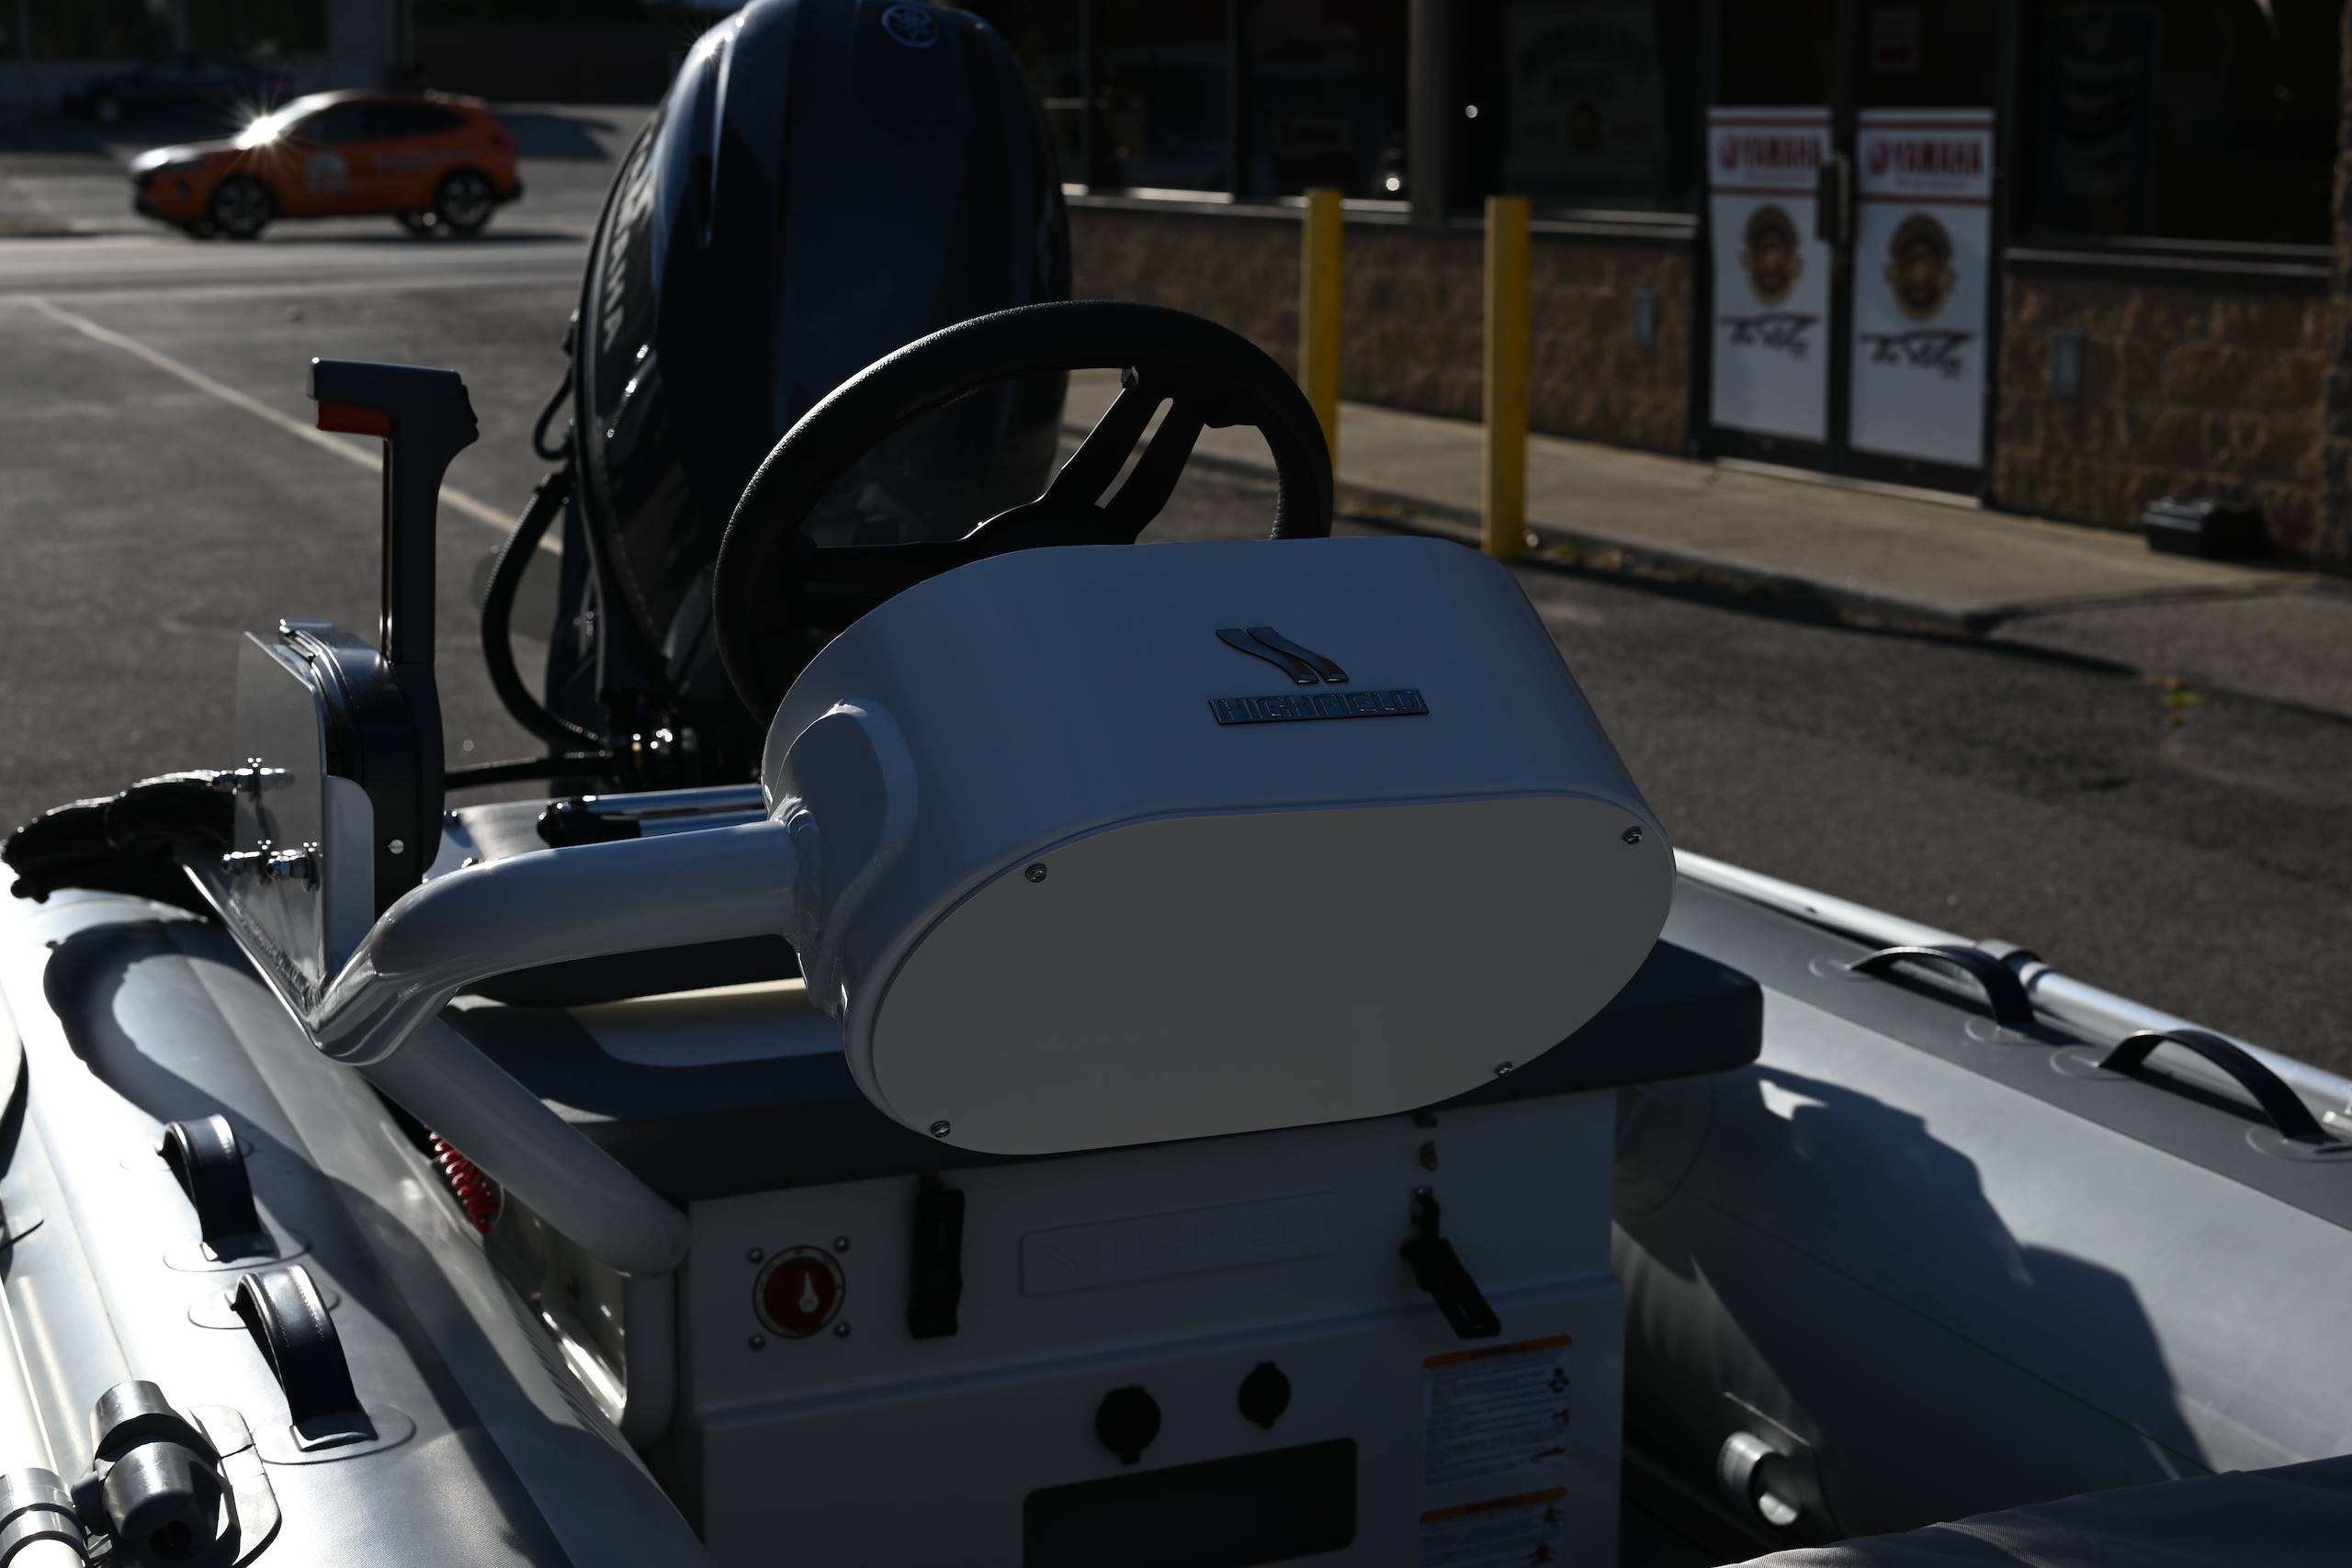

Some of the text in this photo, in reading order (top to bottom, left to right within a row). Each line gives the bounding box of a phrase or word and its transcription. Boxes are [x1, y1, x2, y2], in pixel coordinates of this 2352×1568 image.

[1743, 136, 1823, 168] YAMAHA
[1895, 141, 1984, 175] YAMAHA
[1210, 690, 1428, 724] HIGHFIELD
